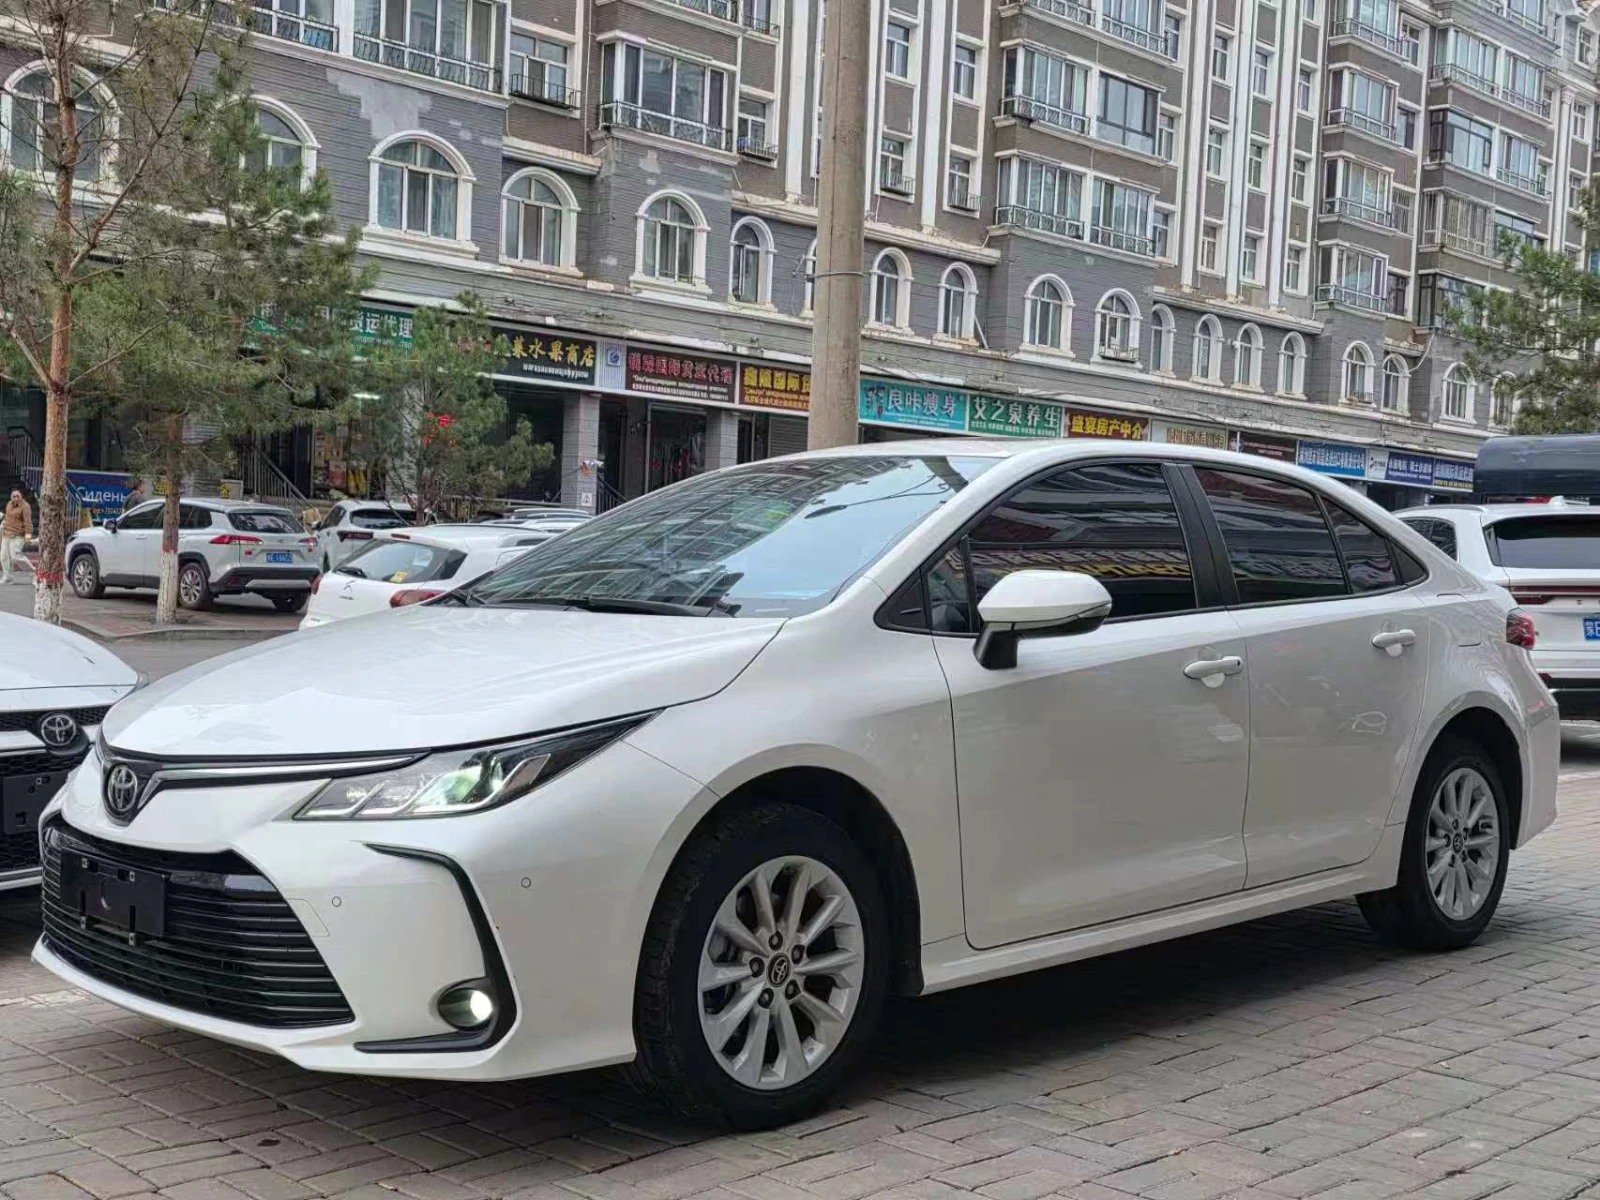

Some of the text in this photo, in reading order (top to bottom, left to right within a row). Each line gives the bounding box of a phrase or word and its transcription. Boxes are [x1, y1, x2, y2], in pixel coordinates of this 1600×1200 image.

[973, 397, 1058, 428] 艾之泉养生
